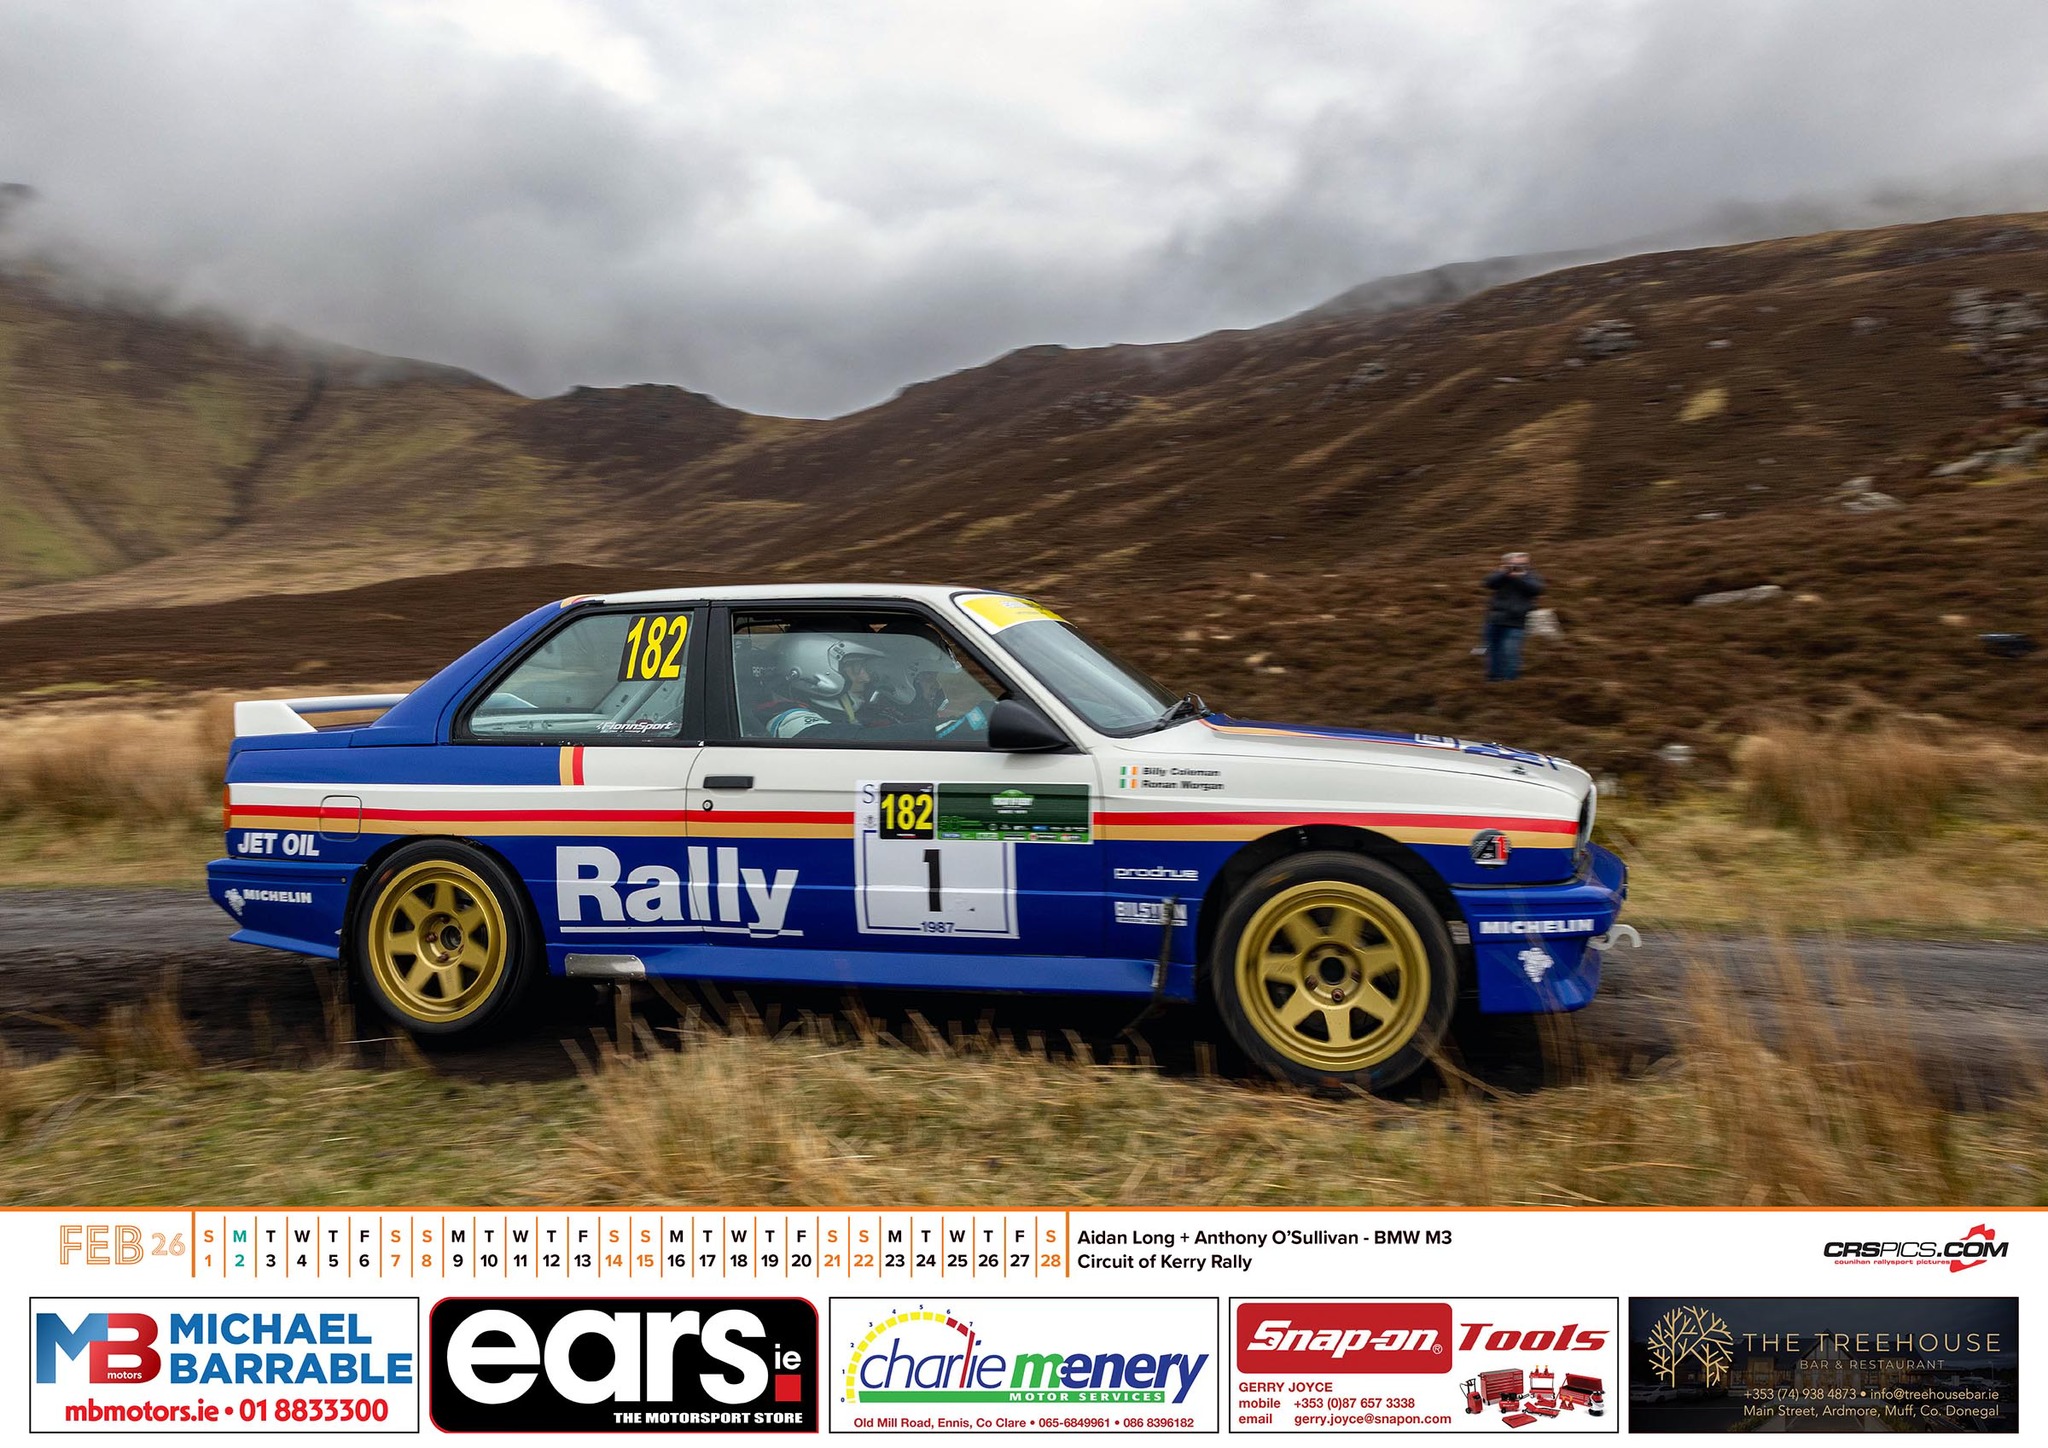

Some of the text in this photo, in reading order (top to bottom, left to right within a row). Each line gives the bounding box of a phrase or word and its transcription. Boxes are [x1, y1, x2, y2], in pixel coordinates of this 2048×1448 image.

[626, 615, 687, 679] 182
[881, 793, 933, 830] 182
[237, 832, 320, 857] JET OIL
[556, 846, 799, 938] Rally
[923, 849, 942, 912] 1
[243, 889, 312, 904] MICHELIN
[1114, 902, 1187, 919] BILSTEN
[921, 922, 955, 935] 1987
[1479, 920, 1594, 934] MICHELIN
